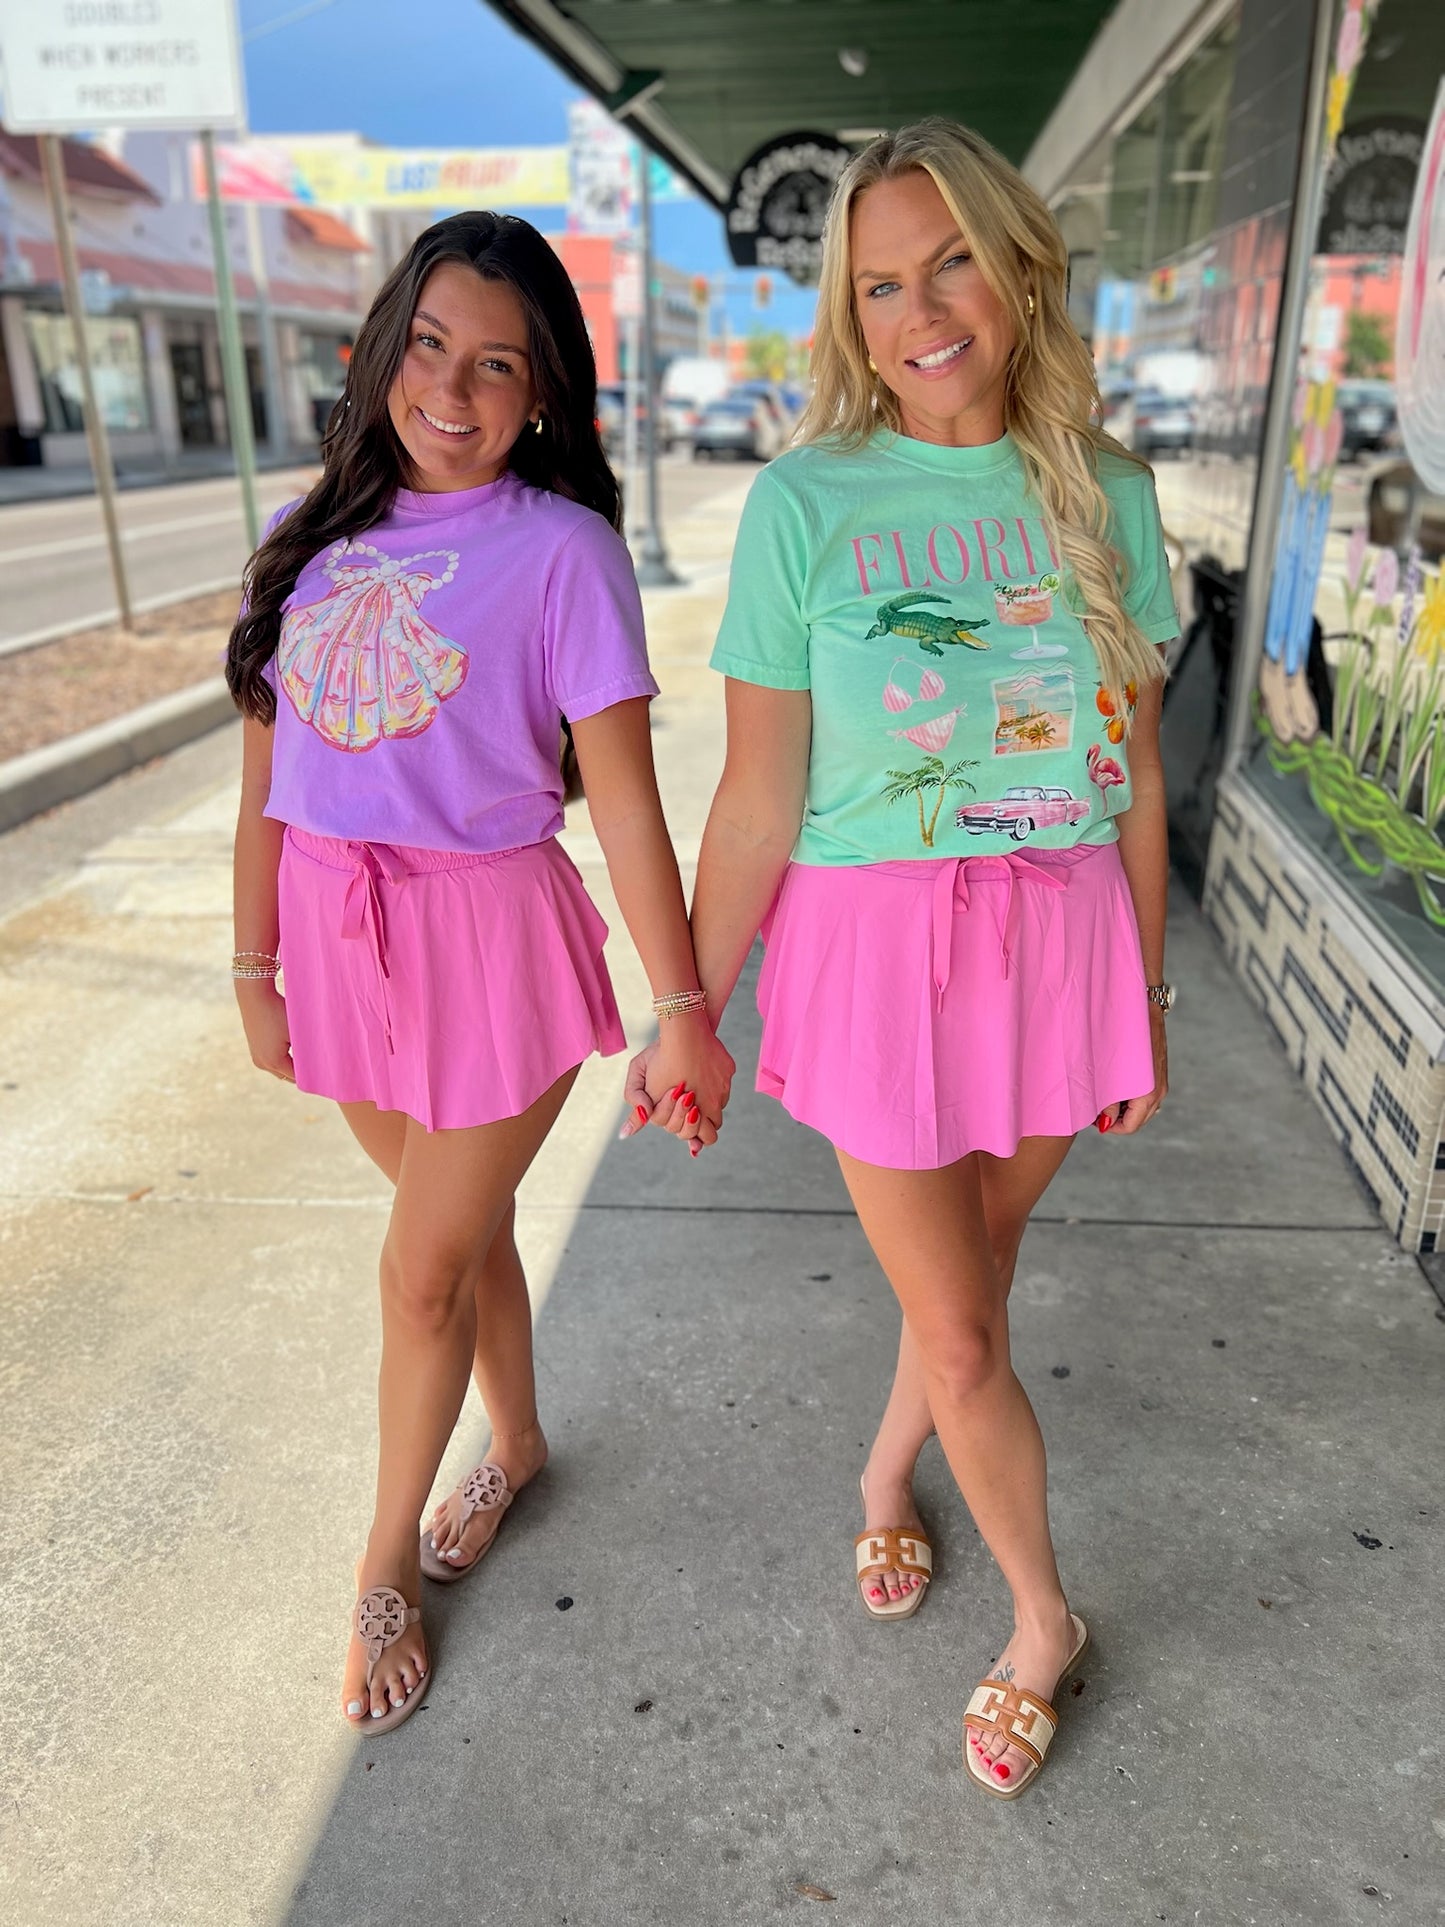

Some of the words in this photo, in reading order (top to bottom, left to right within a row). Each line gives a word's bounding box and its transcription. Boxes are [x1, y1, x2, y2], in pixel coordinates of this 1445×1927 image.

[38, 43, 95, 70] WHEN
[104, 39, 200, 67] WORKERS
[76, 82, 166, 109] PRESENT
